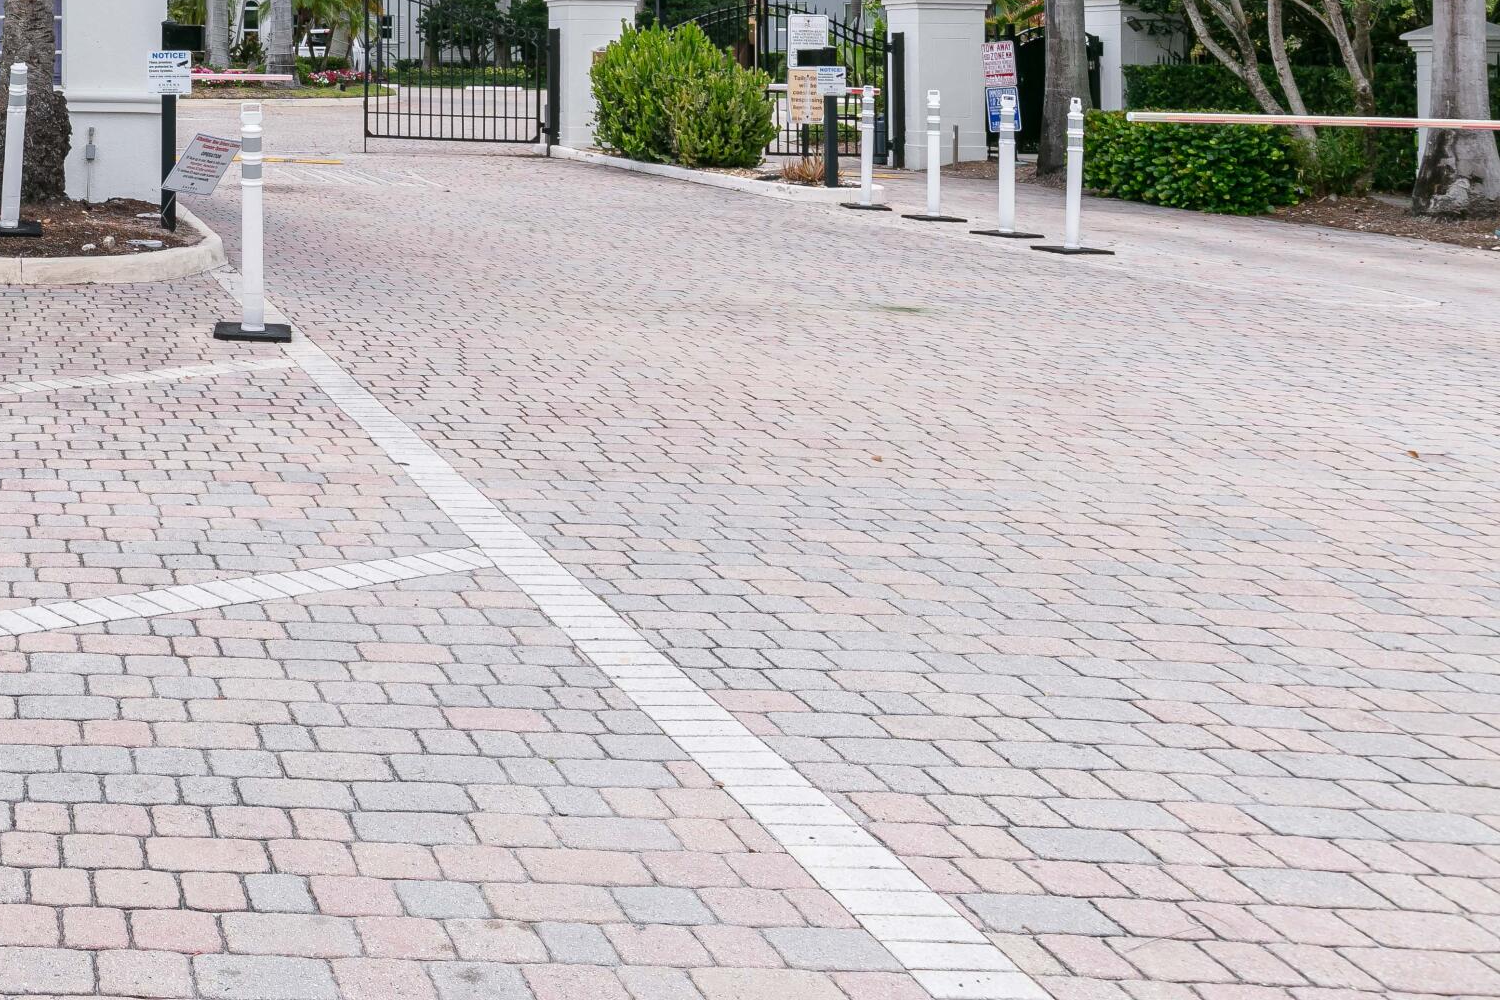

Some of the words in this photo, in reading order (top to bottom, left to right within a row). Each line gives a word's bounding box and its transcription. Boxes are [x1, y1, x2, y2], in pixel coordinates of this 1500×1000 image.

[981, 43, 994, 52] TOW
[997, 43, 1012, 51] AWAY
[990, 52, 1005, 60] ZONE
